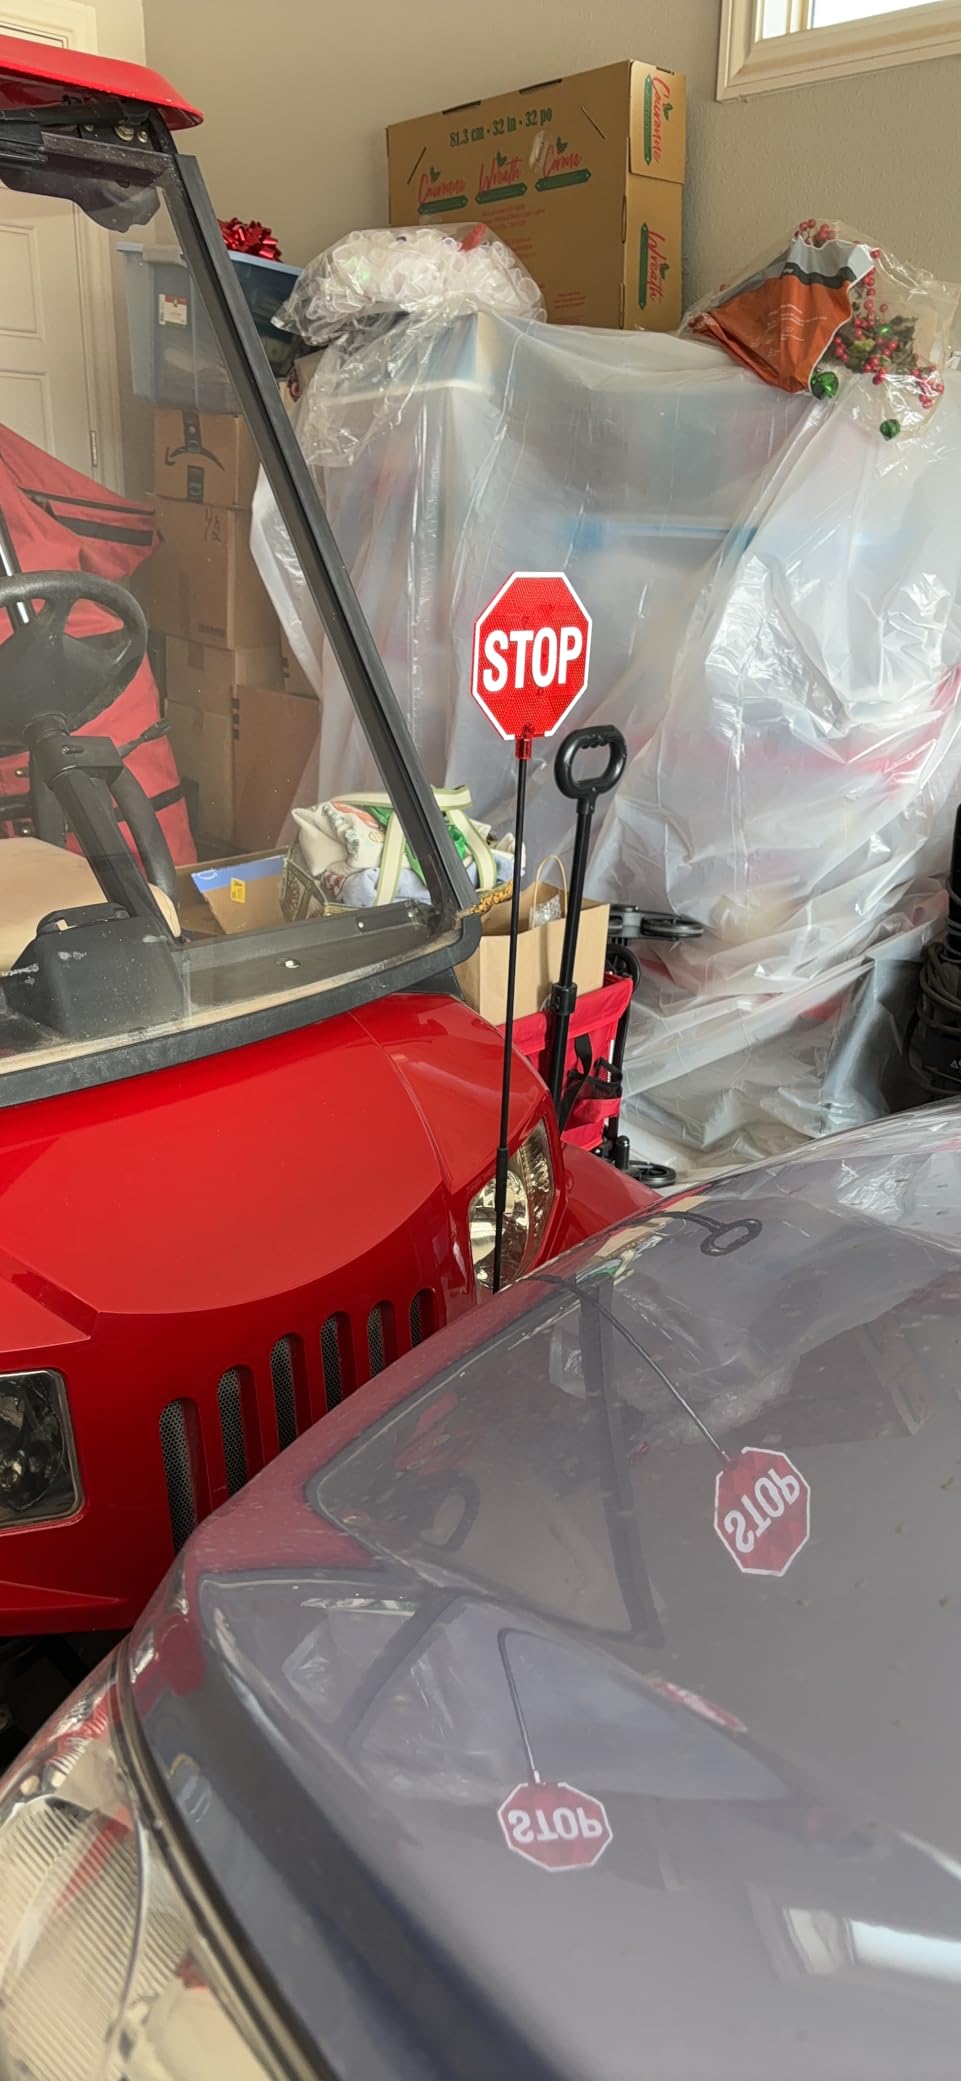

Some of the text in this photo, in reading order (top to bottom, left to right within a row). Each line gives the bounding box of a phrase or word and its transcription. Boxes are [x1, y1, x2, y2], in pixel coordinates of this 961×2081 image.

[449, 128, 469, 147] 81.3
[471, 126, 485, 142] cm
[492, 118, 505, 136] 32
[525, 109, 538, 127] 32
[540, 107, 553, 126] po
[648, 230, 667, 304] Wreath
[483, 626, 583, 692] STOP
